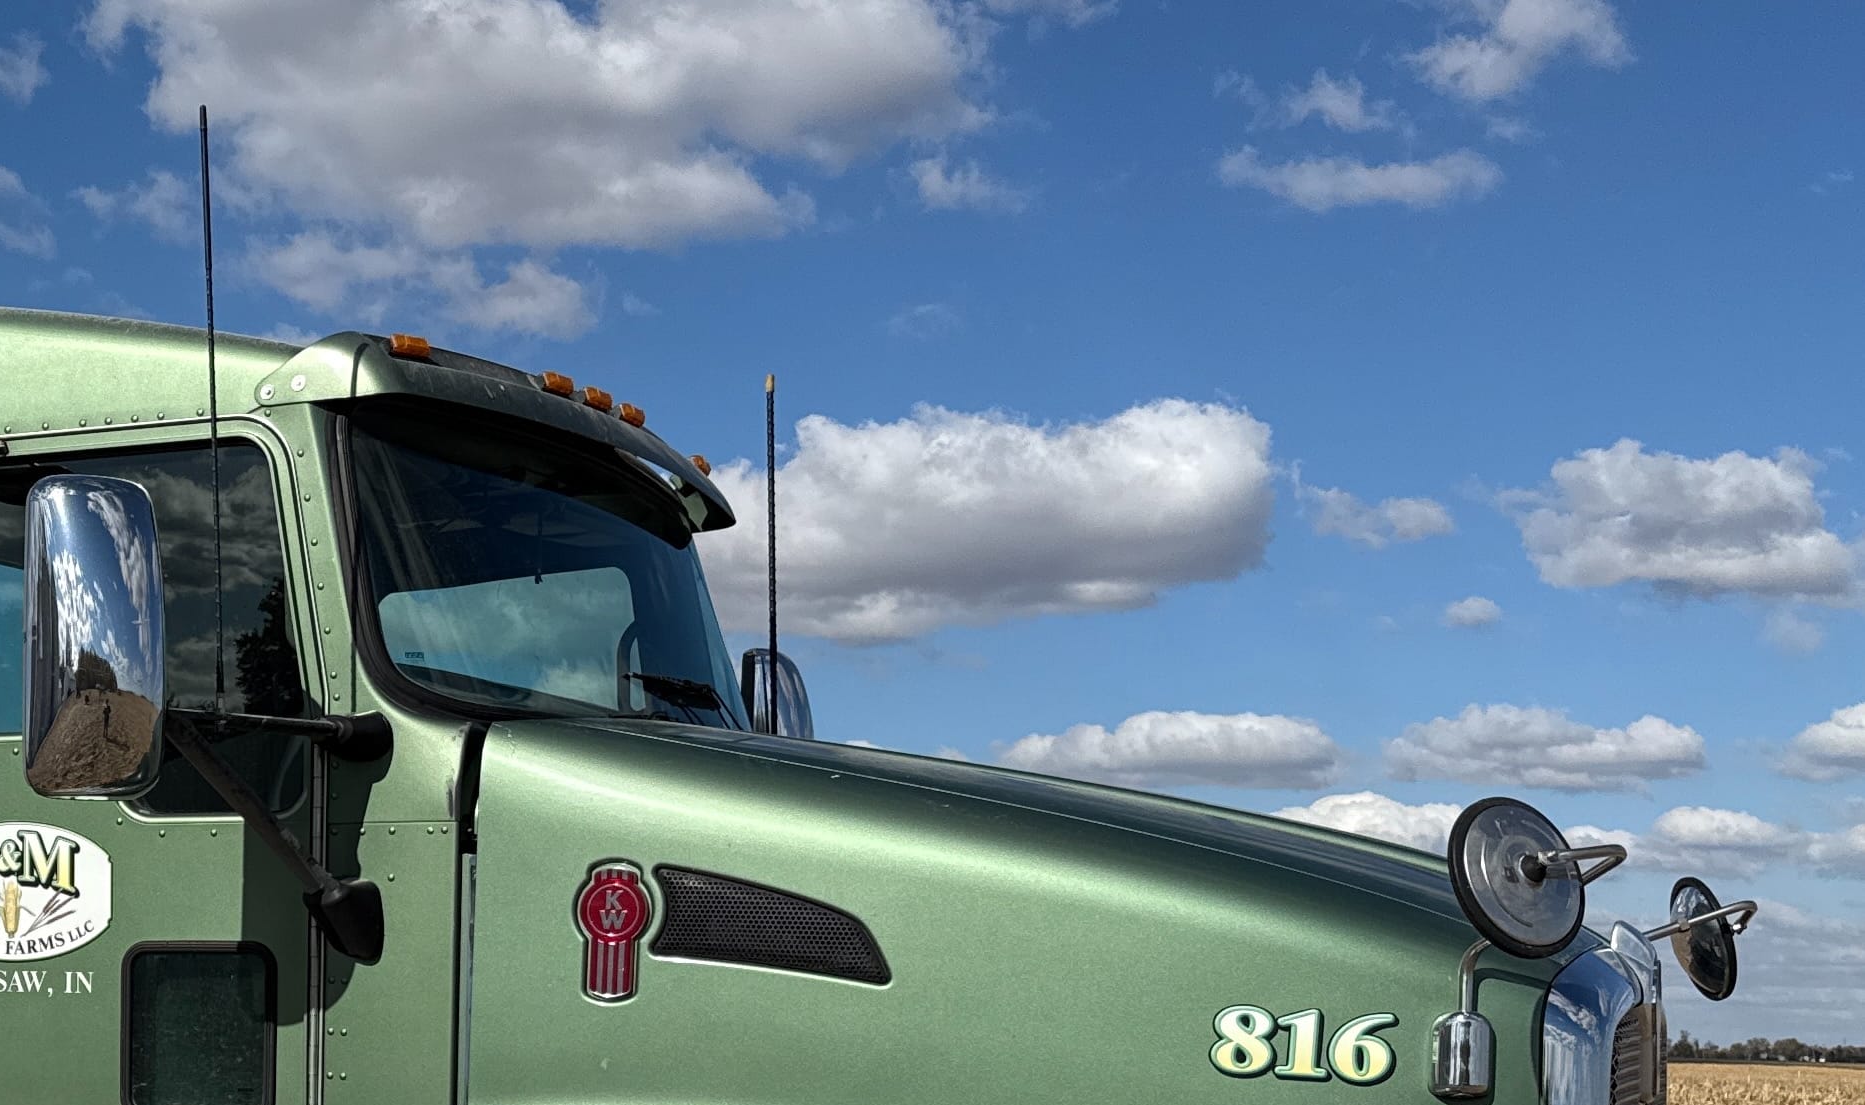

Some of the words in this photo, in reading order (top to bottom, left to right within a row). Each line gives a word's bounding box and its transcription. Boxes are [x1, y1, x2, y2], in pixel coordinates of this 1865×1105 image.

[5, 932, 65, 955] FARMS
[68, 919, 96, 943] LLC
[64, 971, 95, 994] IN
[1209, 1004, 1400, 1086] 816
